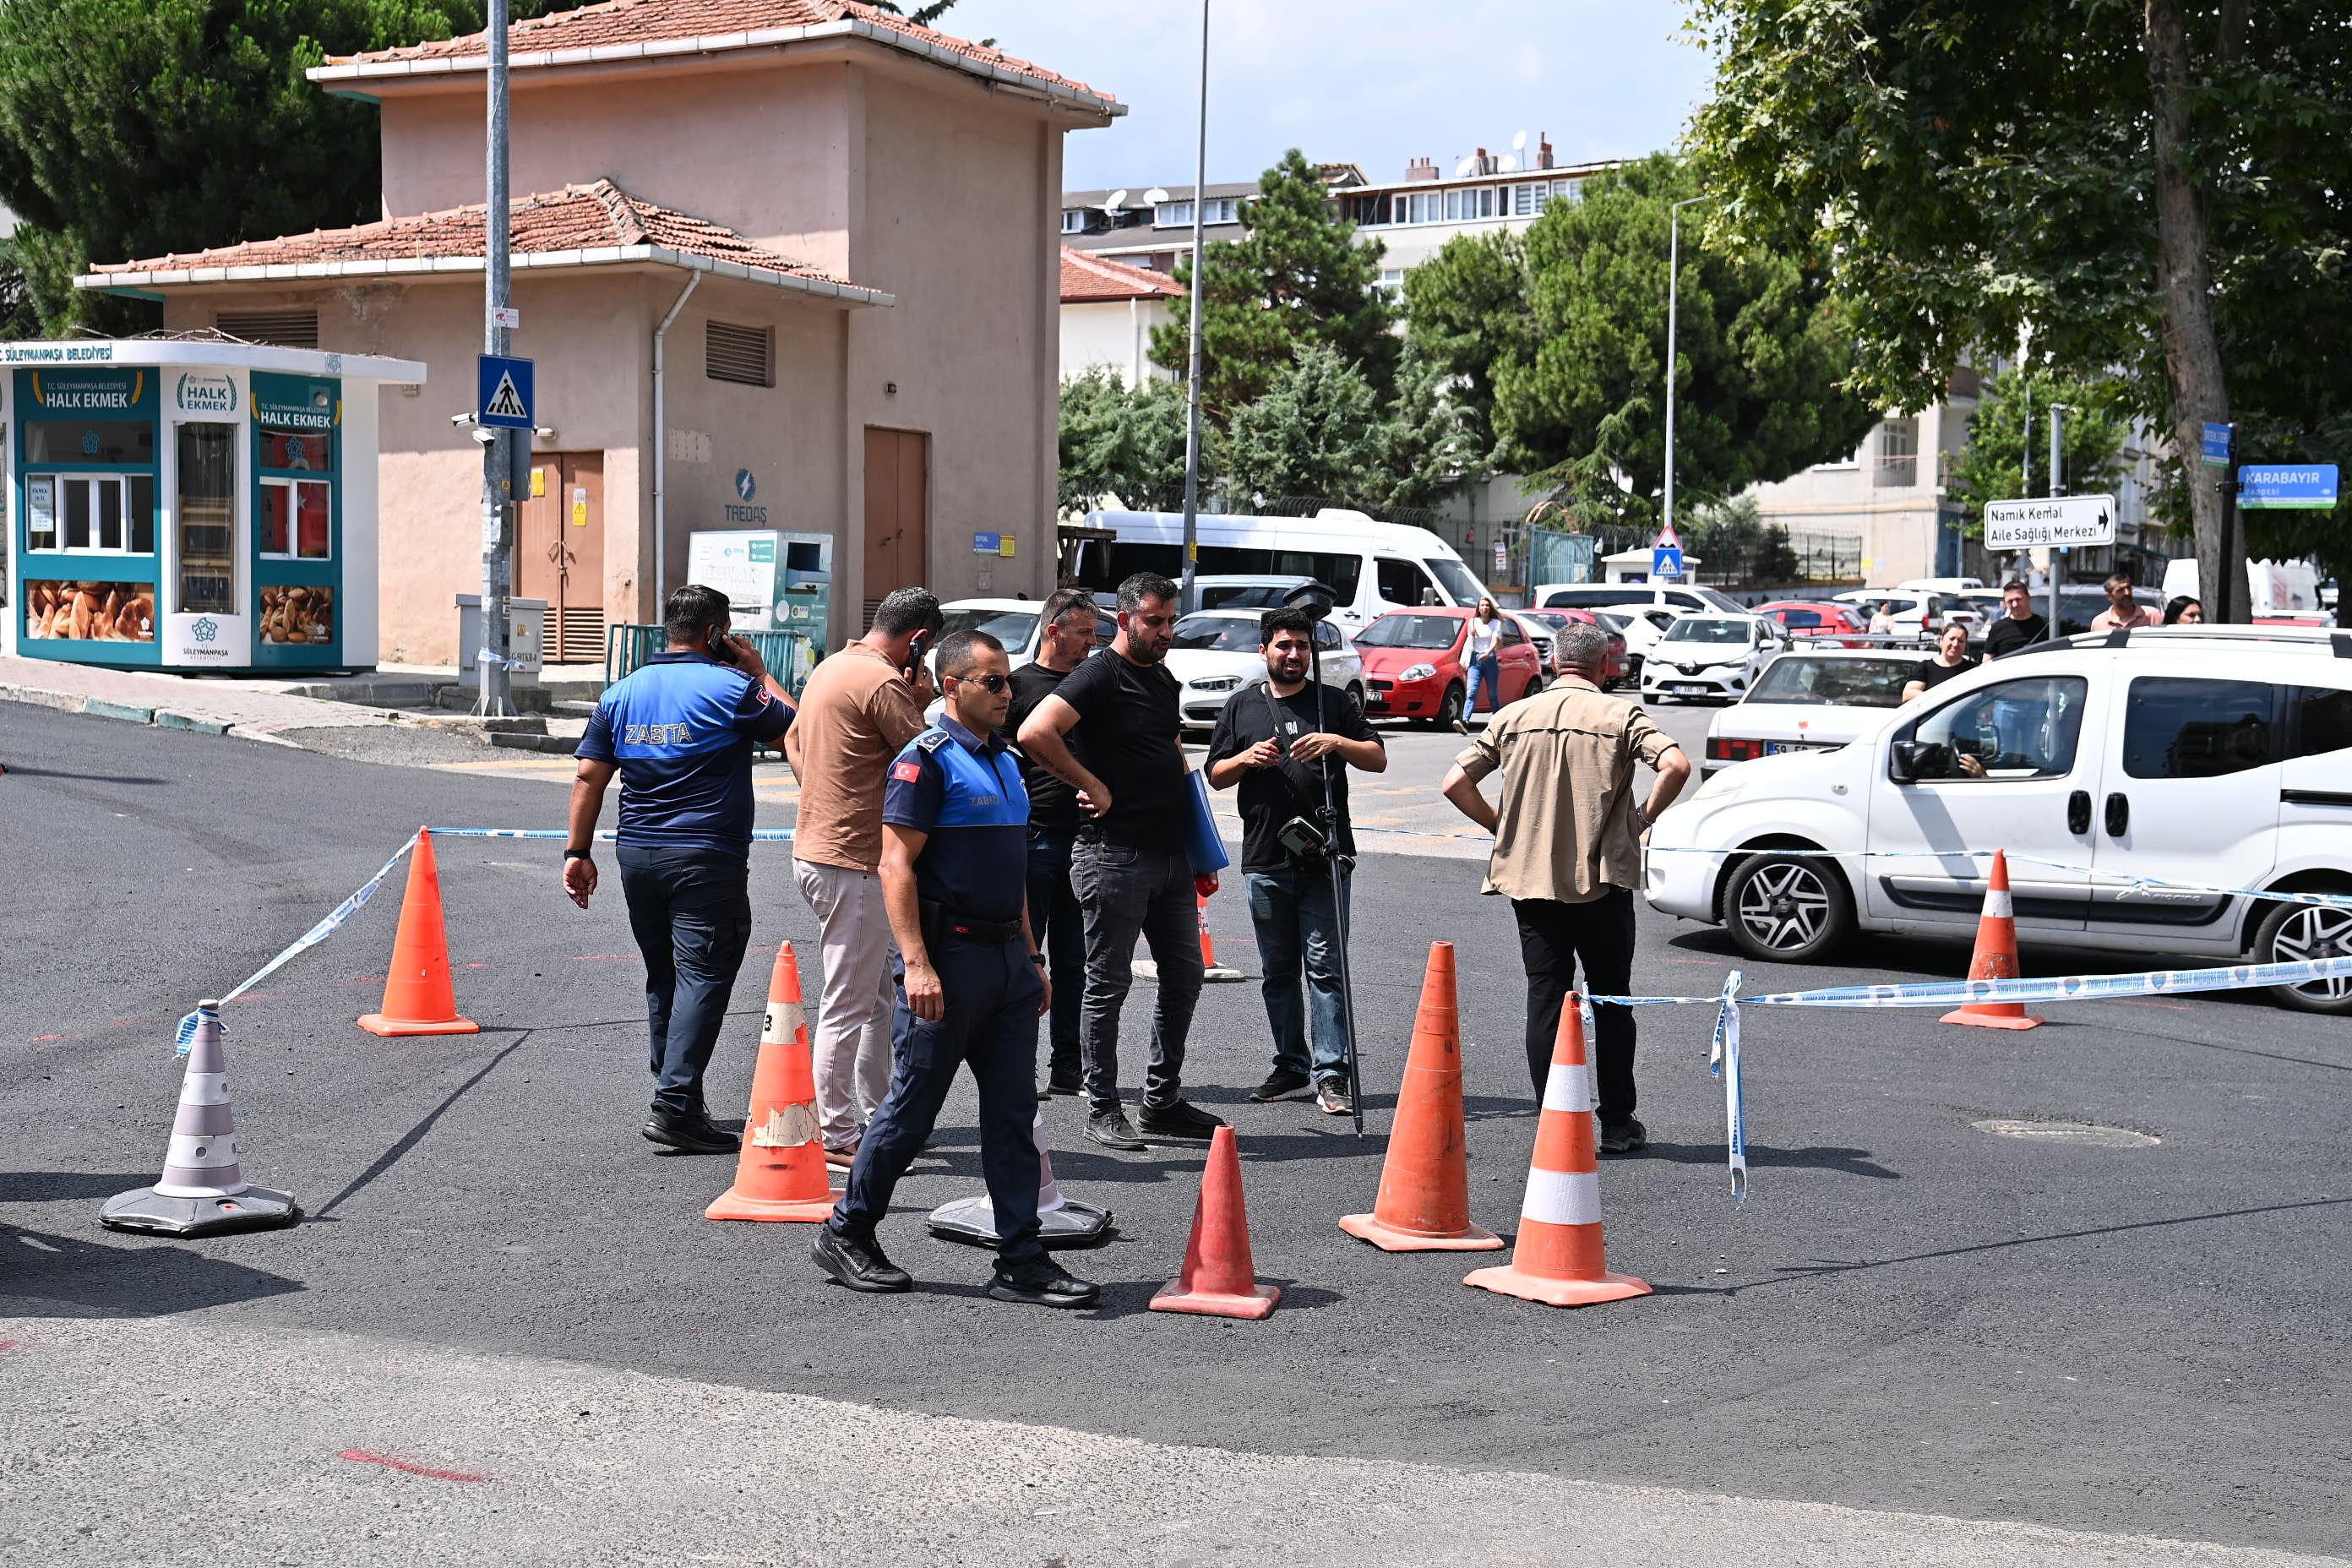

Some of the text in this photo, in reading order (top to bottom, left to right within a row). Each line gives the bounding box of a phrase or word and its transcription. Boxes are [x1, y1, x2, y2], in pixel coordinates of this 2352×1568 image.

[5, 346, 63, 362] SÜLEYMANPAŞA
[67, 343, 112, 361] BELEDİYESİ
[46, 392, 128, 408] HALK EKMEK
[188, 387, 226, 400] HALK
[188, 400, 227, 411] EKMEK
[260, 411, 331, 428] HALK EKMEK
[2246, 472, 2320, 485] KARABAYIR
[724, 504, 767, 526] TREDAŞ
[1991, 505, 2062, 521] Namık Kemal
[1991, 524, 2097, 543] Aile Sağlığı Merkezi
[183, 647, 229, 657] SÜLEYMANPAŞA
[624, 722, 693, 745] ZABITA
[970, 796, 1001, 806] ZABITA
